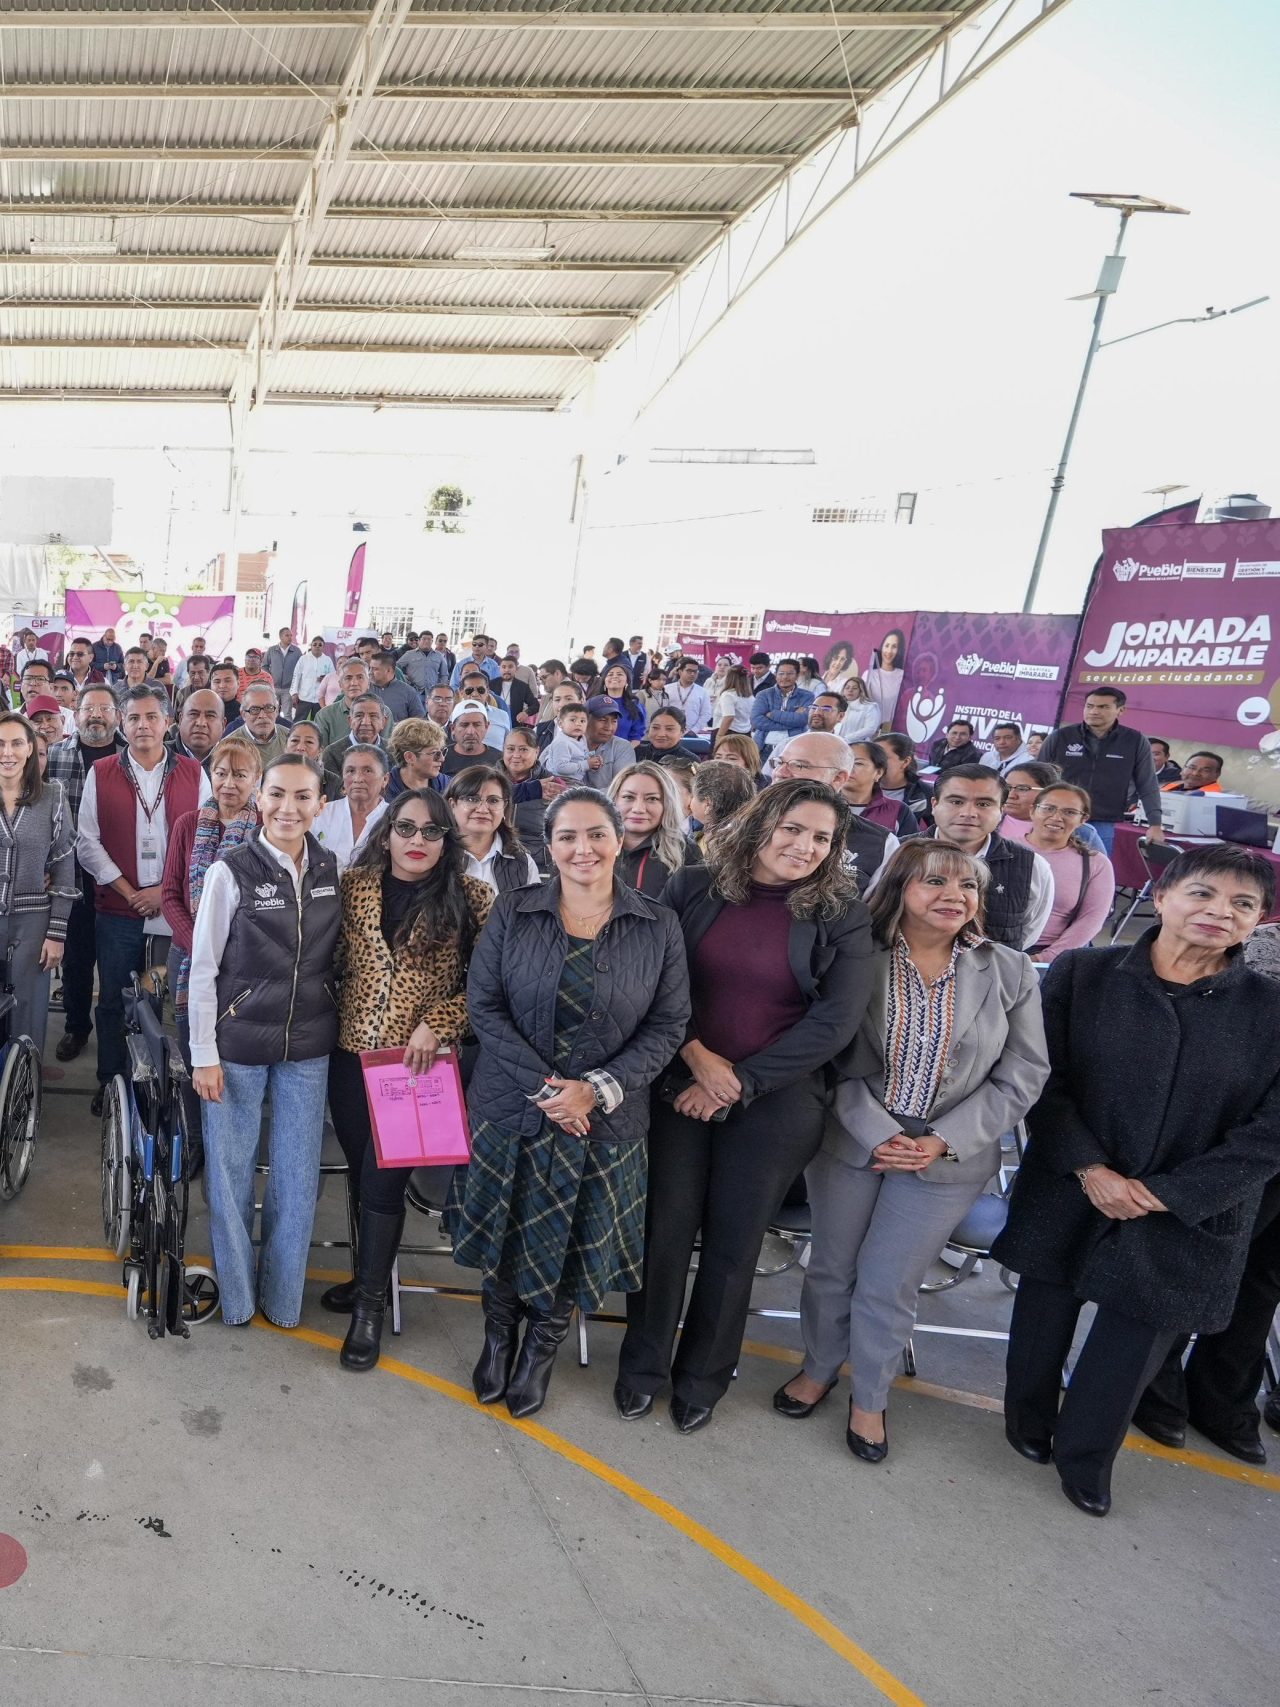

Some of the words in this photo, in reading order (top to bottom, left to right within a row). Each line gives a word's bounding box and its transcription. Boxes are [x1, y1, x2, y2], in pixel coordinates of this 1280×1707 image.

[1138, 563, 1183, 577] Puebla
[1186, 566, 1222, 574] BIENESTAR
[1083, 615, 1272, 667] JORNADA
[1114, 645, 1268, 668] IMPARABLE
[981, 661, 1016, 674] Puebla
[1018, 671, 1054, 679] IMPARABLE
[1086, 673, 1153, 682] servicios
[1159, 672, 1254, 682] ciudadanos
[955, 705, 998, 718] INSTITUTO
[998, 710, 1011, 719] DE
[1011, 712, 1023, 721] LA
[254, 897, 285, 908] Puebla
